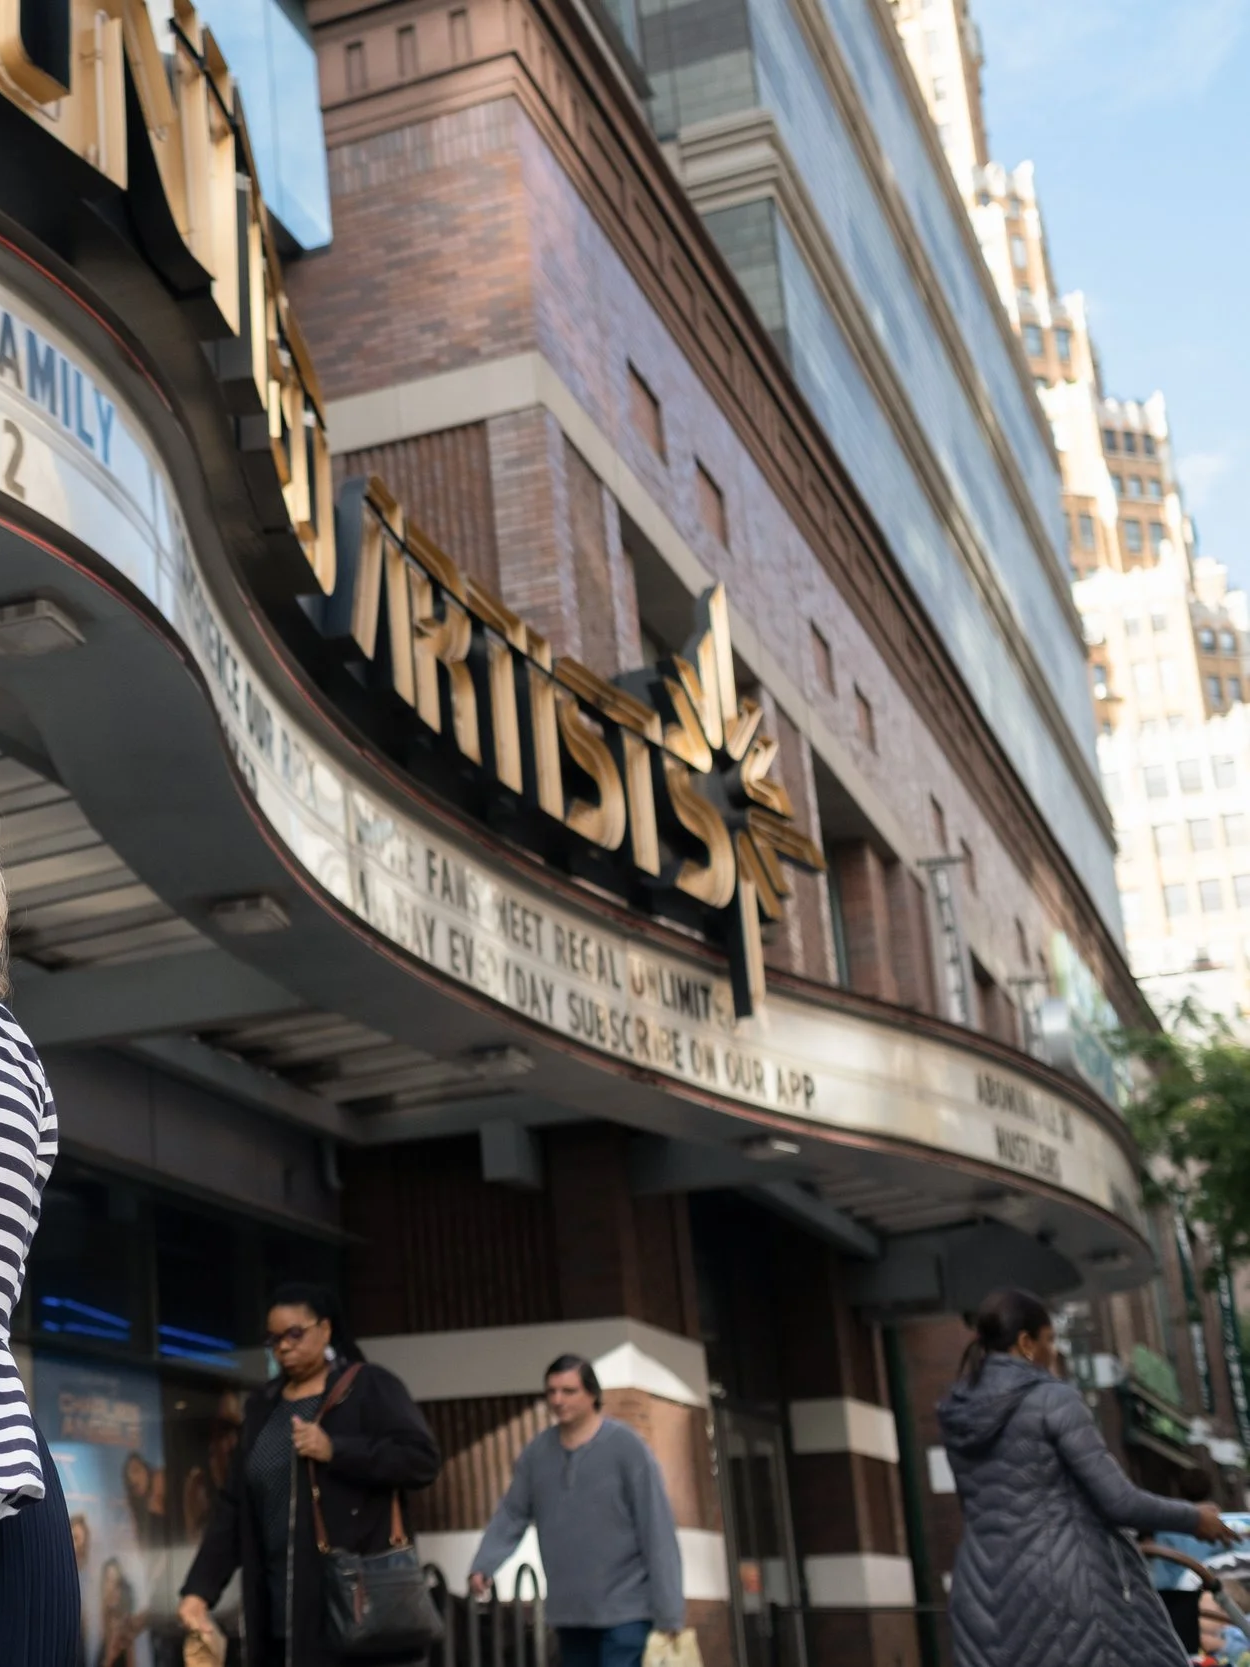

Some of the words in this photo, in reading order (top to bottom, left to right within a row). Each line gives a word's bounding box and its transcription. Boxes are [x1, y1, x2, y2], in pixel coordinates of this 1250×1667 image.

[0, 418, 28, 498] 2
[350, 476, 738, 910] ARTISTS
[554, 921, 622, 990] REGAL
[630, 956, 736, 1036] UNLIMITE
[567, 992, 683, 1070] SUBSCRIBE
[725, 1050, 767, 1101] OUR
[777, 1068, 817, 1112] APP
